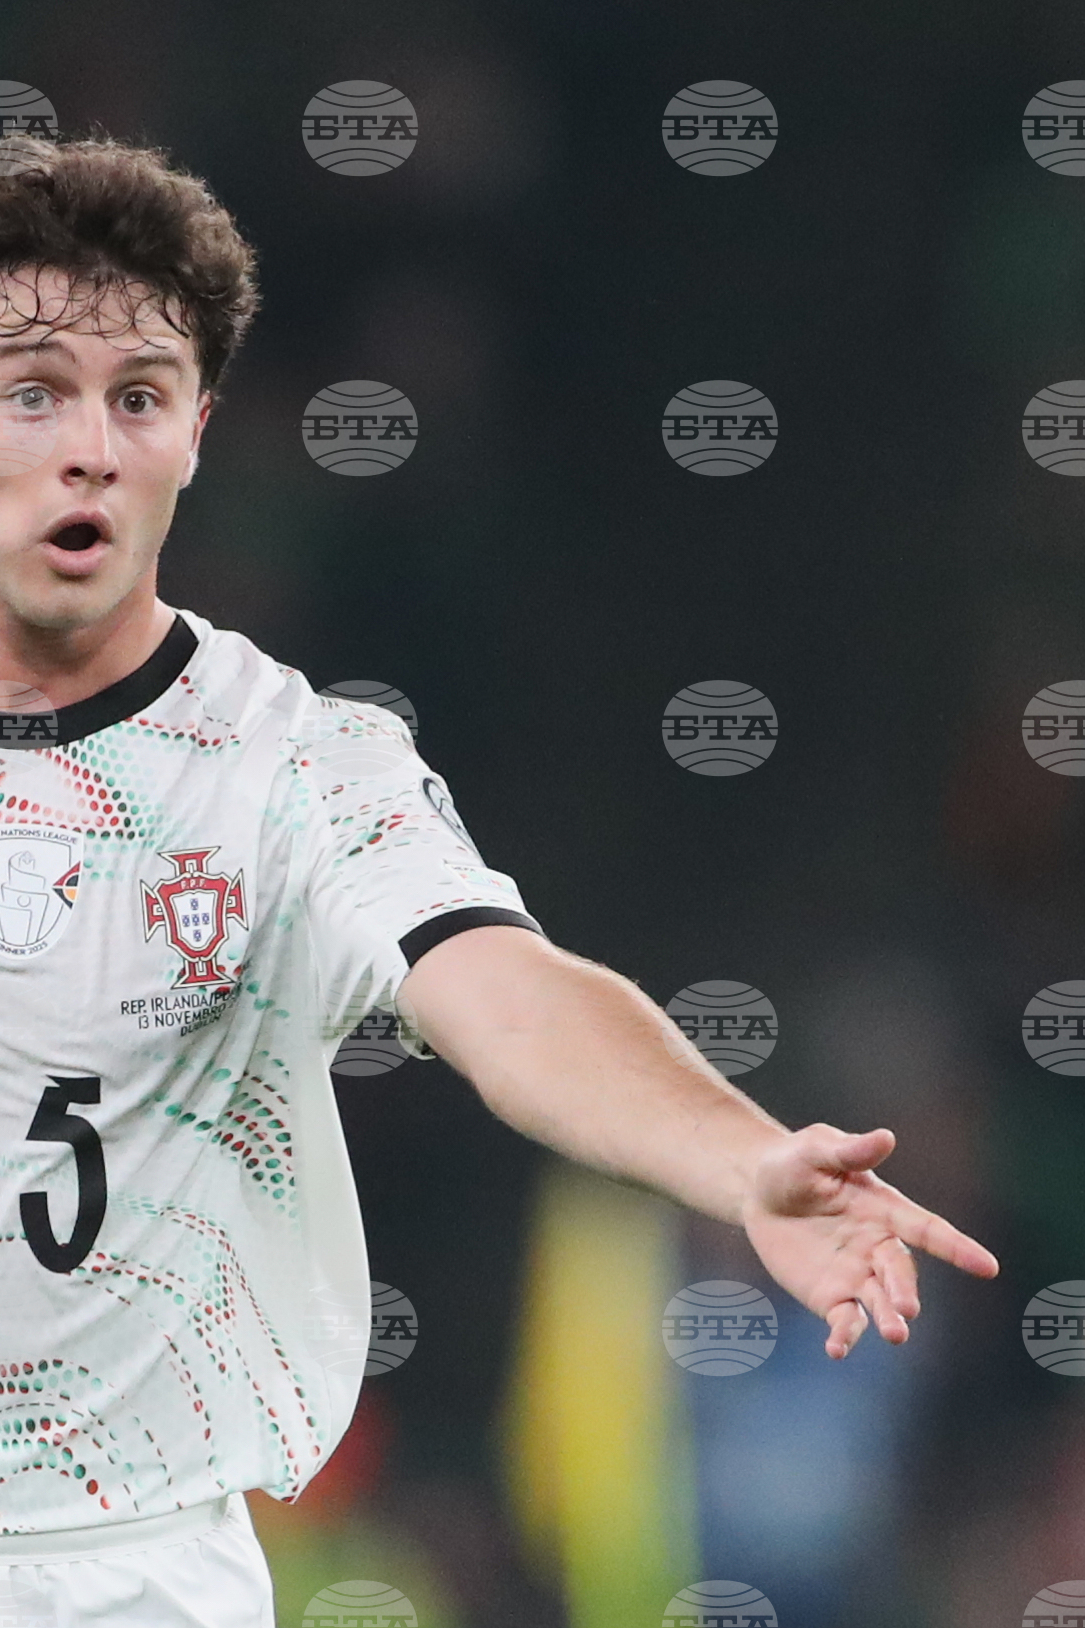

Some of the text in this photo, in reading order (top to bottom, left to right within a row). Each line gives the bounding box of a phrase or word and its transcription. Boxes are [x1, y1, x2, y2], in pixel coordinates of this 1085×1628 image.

[1, 829, 41, 838] NATIONS
[43, 831, 78, 845] LEAGUE
[120, 999, 147, 1015] REP.
[138, 1015, 150, 1029] 13
[155, 1003, 226, 1028] NOVEMBRO
